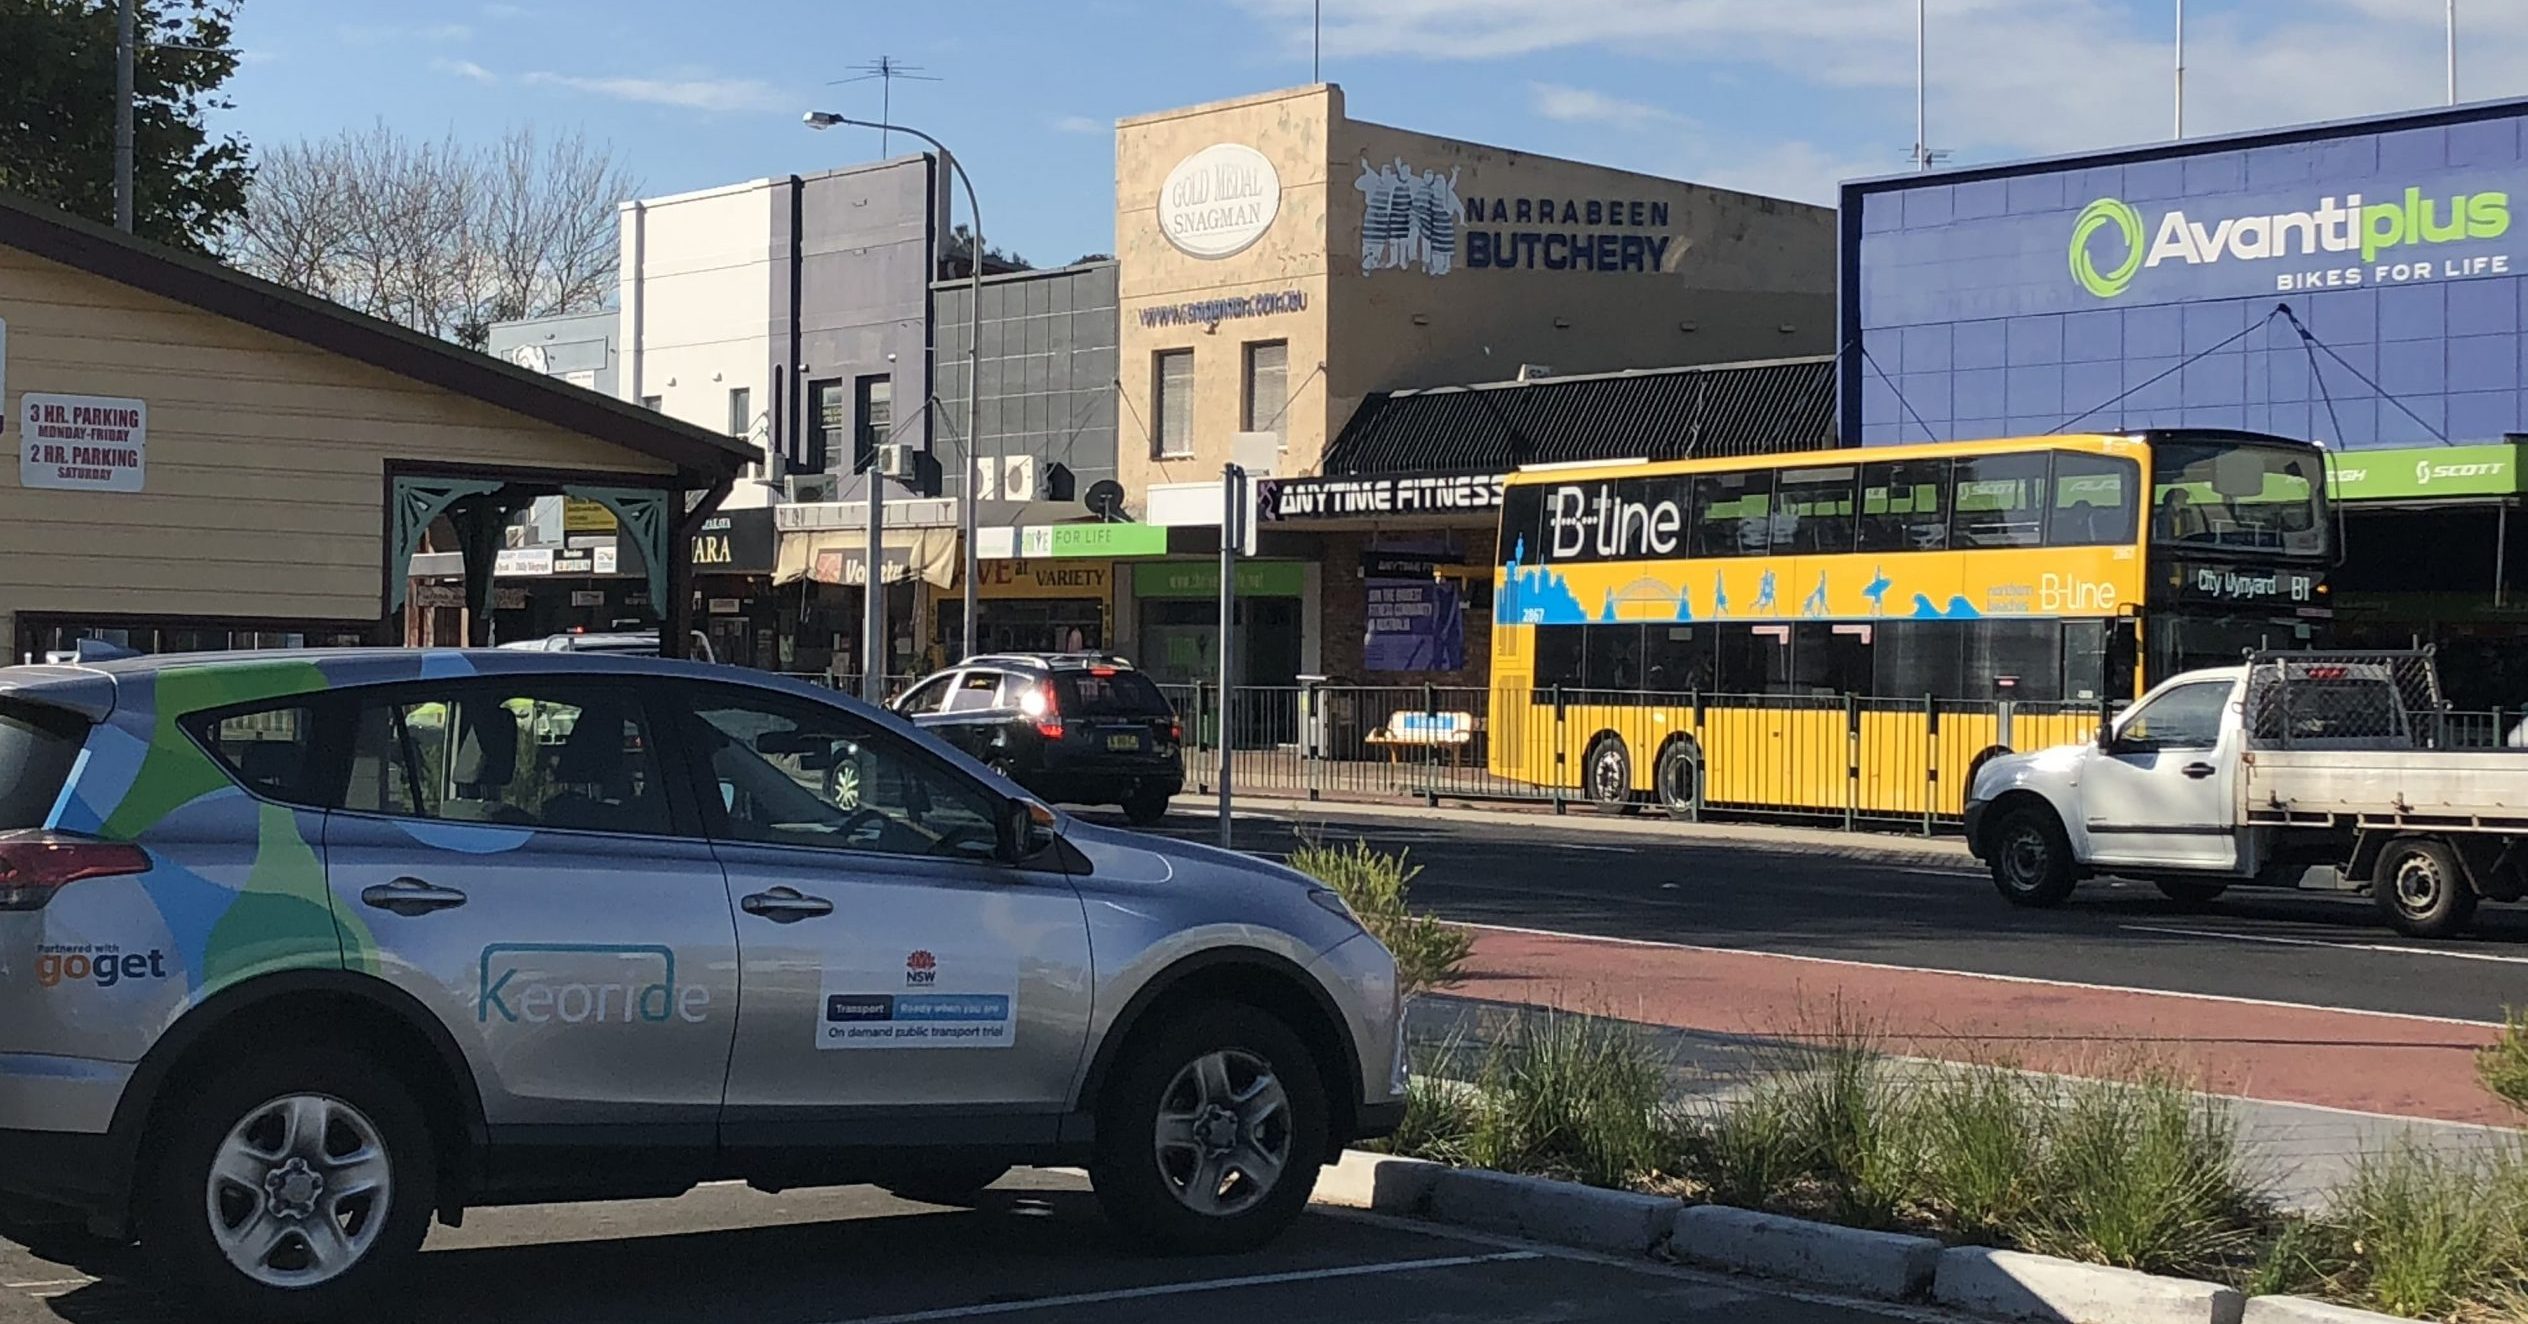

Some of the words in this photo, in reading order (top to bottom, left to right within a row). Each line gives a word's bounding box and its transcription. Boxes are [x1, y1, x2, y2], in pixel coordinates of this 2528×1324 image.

[1173, 169, 1209, 208] GOLD
[1214, 163, 1262, 201] MEDAL
[1174, 203, 1262, 235] SNAGMAN
[1467, 197, 1669, 226] NARRABEEN
[2144, 186, 2510, 267] Avantiplus
[1467, 231, 1670, 273] BUTCHERY
[2277, 267, 2361, 292] BIKES
[2375, 262, 2432, 284] FOR
[2445, 255, 2509, 278] LIFE
[30, 404, 40, 422] 3
[44, 405, 69, 423] HR.
[72, 406, 139, 428] PARKING
[38, 425, 130, 442] MONDAY-FRIDAY
[30, 444, 40, 463] 2
[44, 445, 69, 464] HR.
[72, 446, 138, 468] PARKING
[57, 466, 112, 481] SATURDAY
[2431, 462, 2506, 478] SCOTT
[1278, 480, 1391, 515] ANYTIME
[1396, 474, 1505, 509] FITNESS
[1055, 530, 1080, 545] FOR
[1086, 528, 1112, 544] LIFE
[1035, 569, 1106, 587] VARIETY
[2198, 569, 2222, 597] City
[2291, 576, 2311, 601] B1
[37, 943, 92, 953] Partnered
[94, 943, 120, 953] with
[35, 949, 166, 987] goget
[906, 971, 936, 983] NSW
[478, 944, 711, 1023] Keoride
[836, 1003, 885, 1015] Transport
[828, 1027, 845, 1038] On
[848, 1026, 893, 1037] demand
[895, 1026, 928, 1039] public
[931, 1026, 980, 1039] transport
[982, 1025, 1003, 1037] trial
